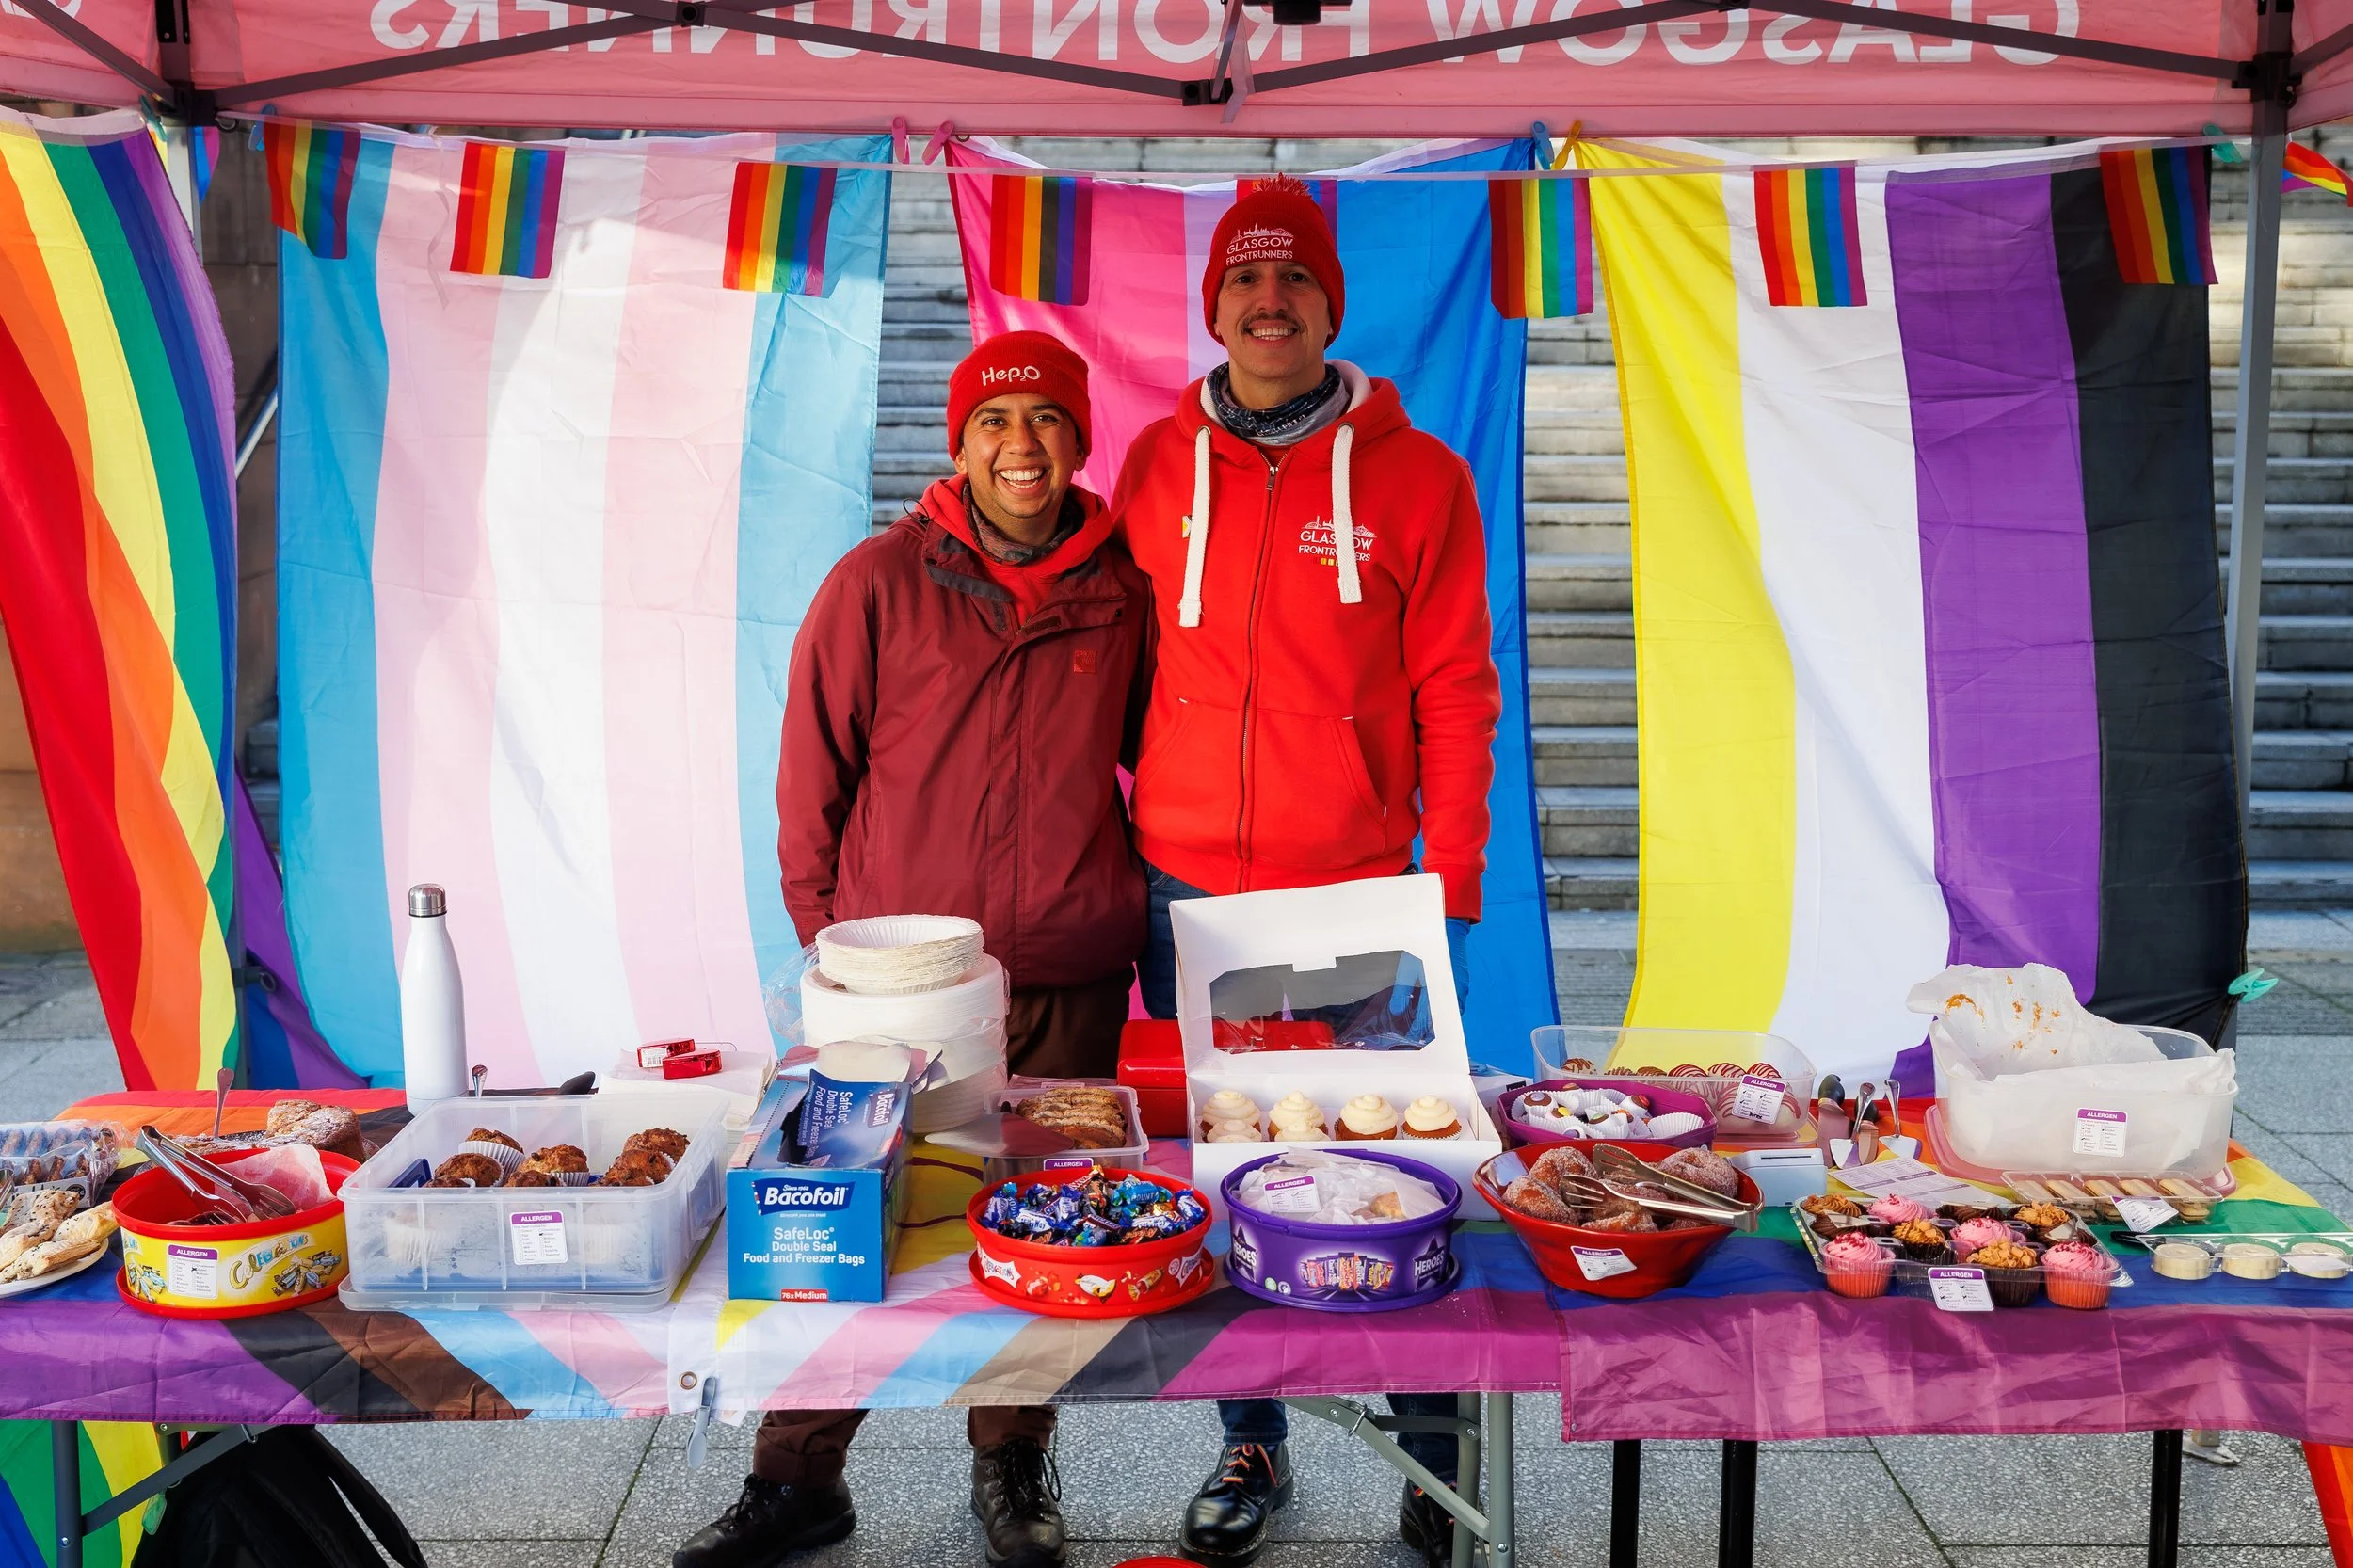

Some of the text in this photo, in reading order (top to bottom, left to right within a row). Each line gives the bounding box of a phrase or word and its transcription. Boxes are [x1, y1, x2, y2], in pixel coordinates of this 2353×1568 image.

[1226, 236, 1294, 255] GLASGOW
[1226, 249, 1294, 266] FRONTRUNNERS
[1300, 530, 1373, 551] GLASOW
[1299, 544, 1371, 562] FRONTRERS
[1751, 1079, 1778, 1089] ALLERGEN
[814, 1086, 826, 1107] Food
[826, 1090, 838, 1114] Double
[812, 1107, 824, 1120] and
[872, 1094, 893, 1125] Bacofoil
[1273, 1178, 1305, 1189] ALLERGEN
[764, 1187, 846, 1206] Bacofoil
[177, 1249, 208, 1257] ALLERGEN
[772, 1241, 837, 1252] Double Seal
[744, 1253, 865, 1267] Food and Freezer Bags
[1415, 1250, 1445, 1276] HEROES
